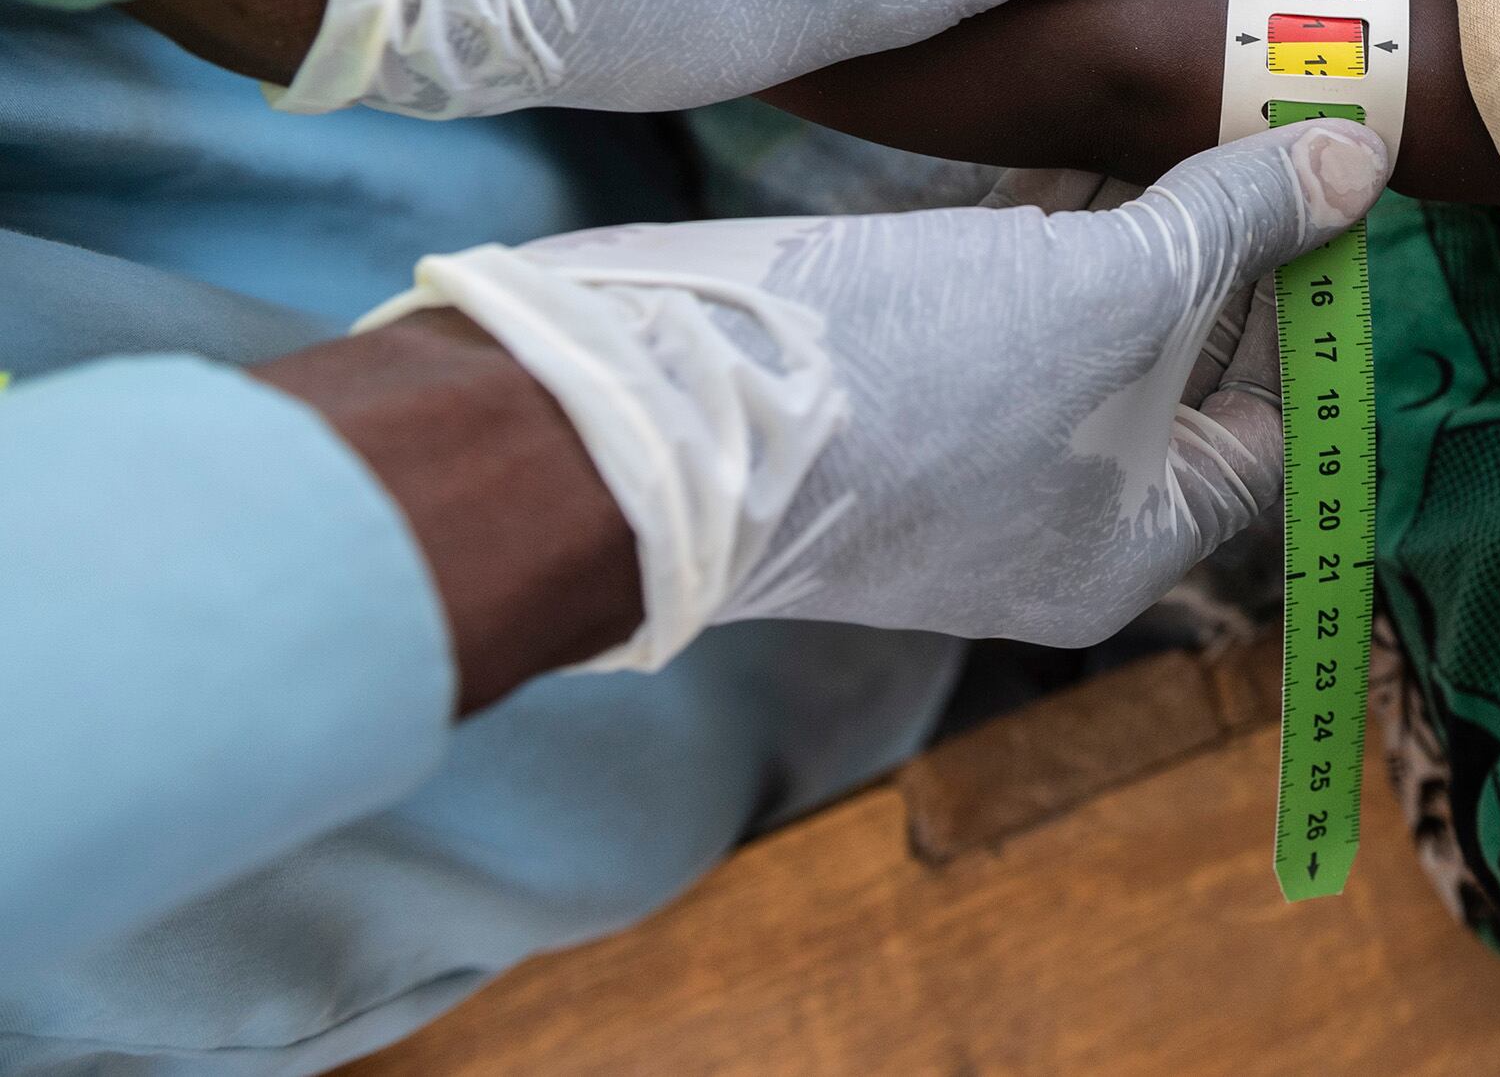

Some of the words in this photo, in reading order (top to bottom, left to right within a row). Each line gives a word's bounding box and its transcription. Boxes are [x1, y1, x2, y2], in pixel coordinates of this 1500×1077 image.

[1309, 274, 1334, 307] 16
[1314, 331, 1338, 363] 17
[1317, 388, 1340, 421] 18
[1318, 444, 1341, 476] 19
[1318, 498, 1341, 531] 20
[1318, 553, 1341, 584] 21
[1317, 607, 1340, 640] 22
[1315, 659, 1338, 692] 23
[1312, 710, 1335, 743] 24
[1309, 760, 1332, 792] 25
[1306, 809, 1329, 841] 26
